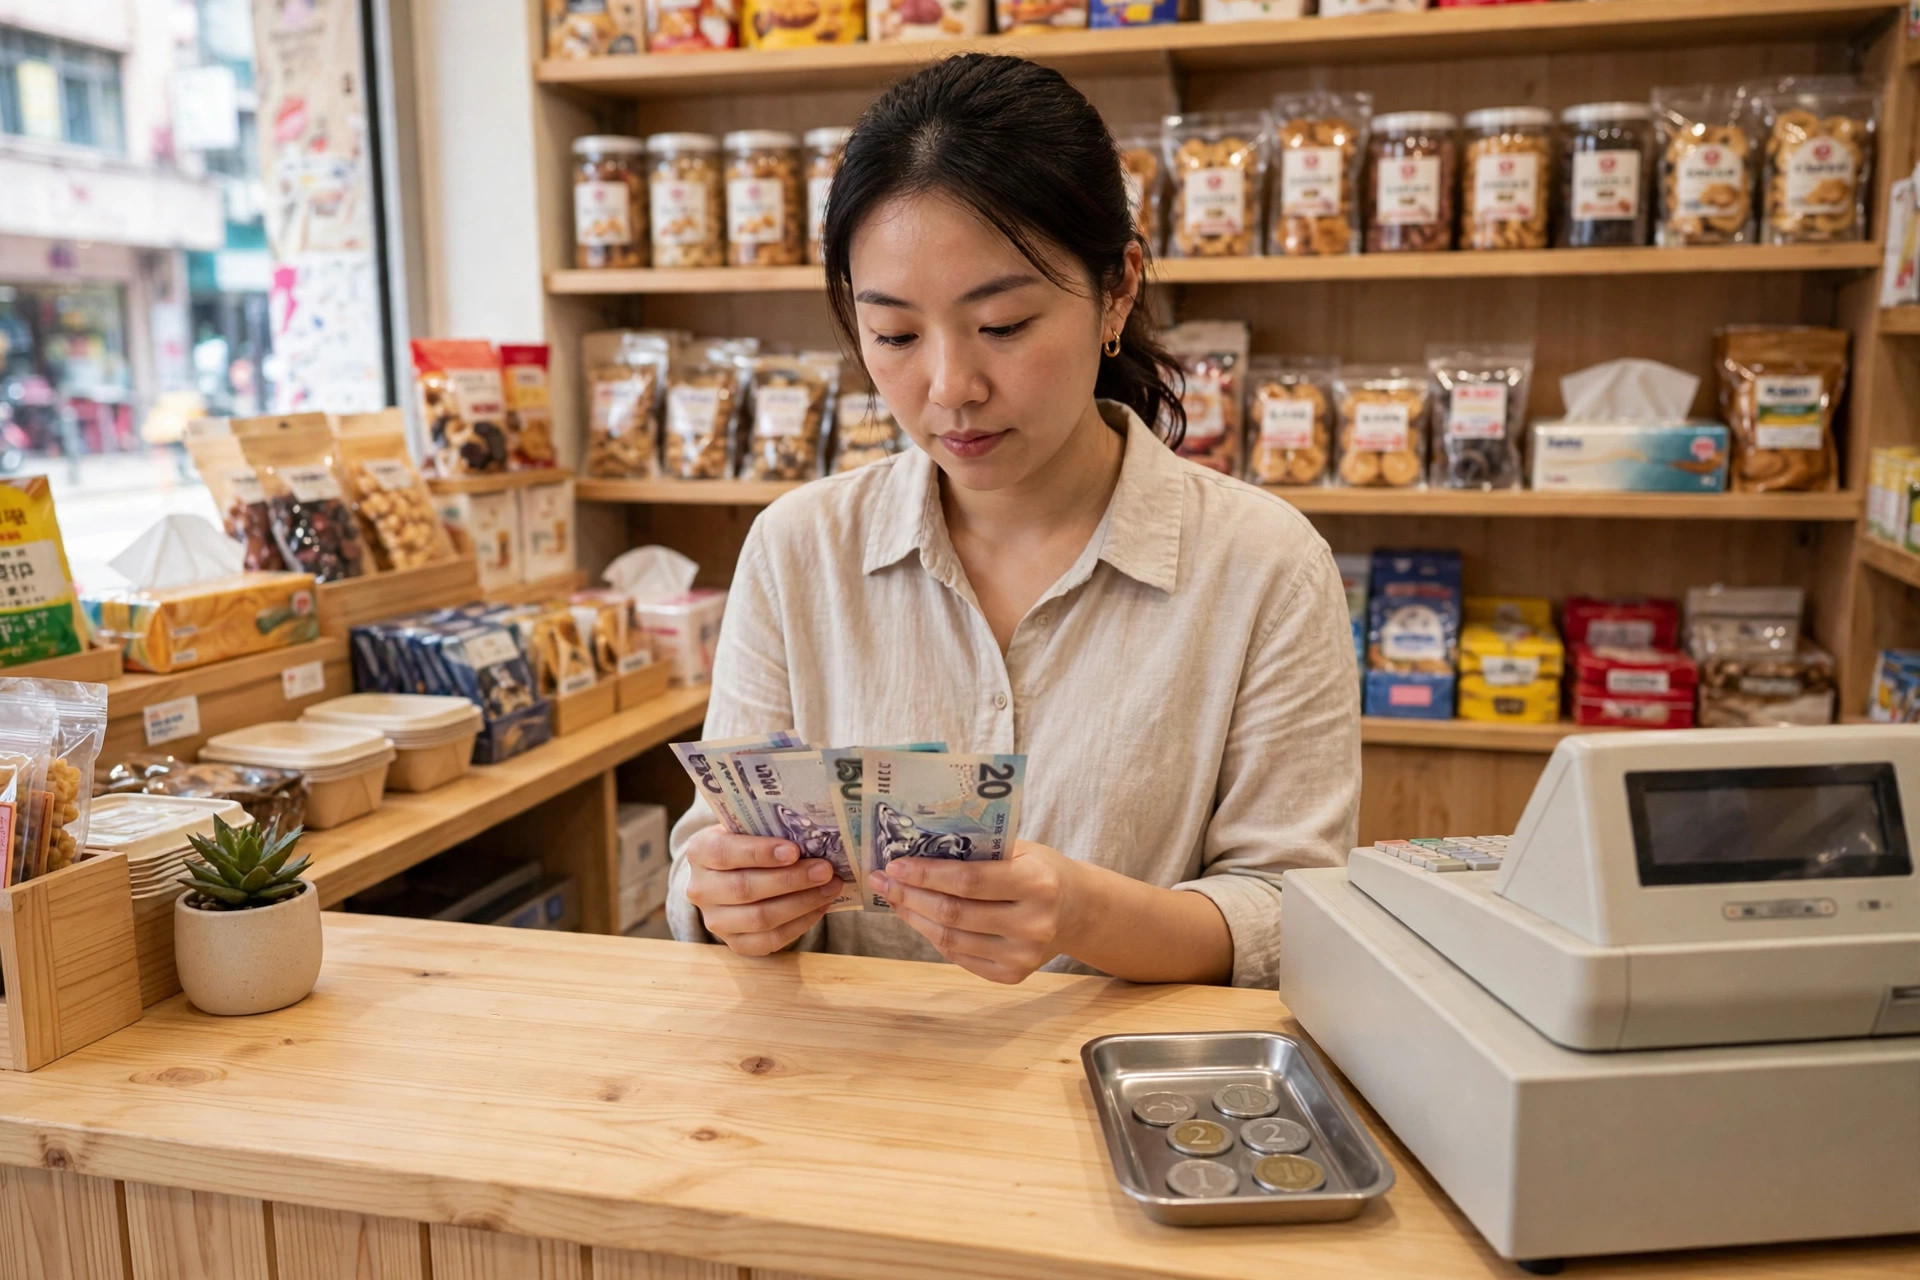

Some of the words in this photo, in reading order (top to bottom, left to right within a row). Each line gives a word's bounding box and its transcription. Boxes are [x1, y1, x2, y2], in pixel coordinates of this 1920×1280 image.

[976, 762, 1015, 800] 20
[1189, 1126, 1212, 1145] 2
[1262, 1123, 1286, 1143] 2
[1193, 1167, 1214, 1189] 1
